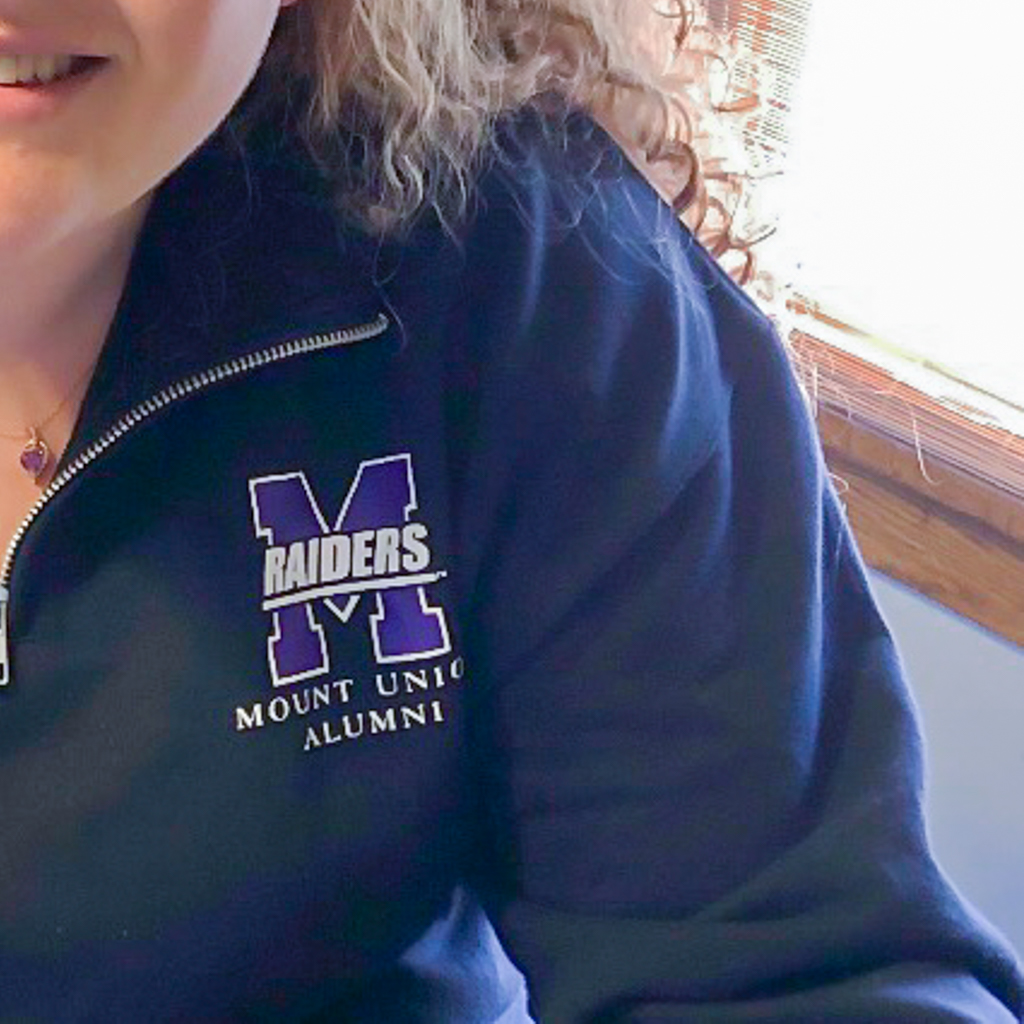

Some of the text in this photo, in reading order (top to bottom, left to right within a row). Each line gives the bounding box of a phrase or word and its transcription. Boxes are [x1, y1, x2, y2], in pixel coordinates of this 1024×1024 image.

[249, 453, 451, 687] M
[264, 523, 431, 596] RAIDERS
[236, 679, 353, 730] MOUNT
[303, 700, 444, 751] ALUMNI
